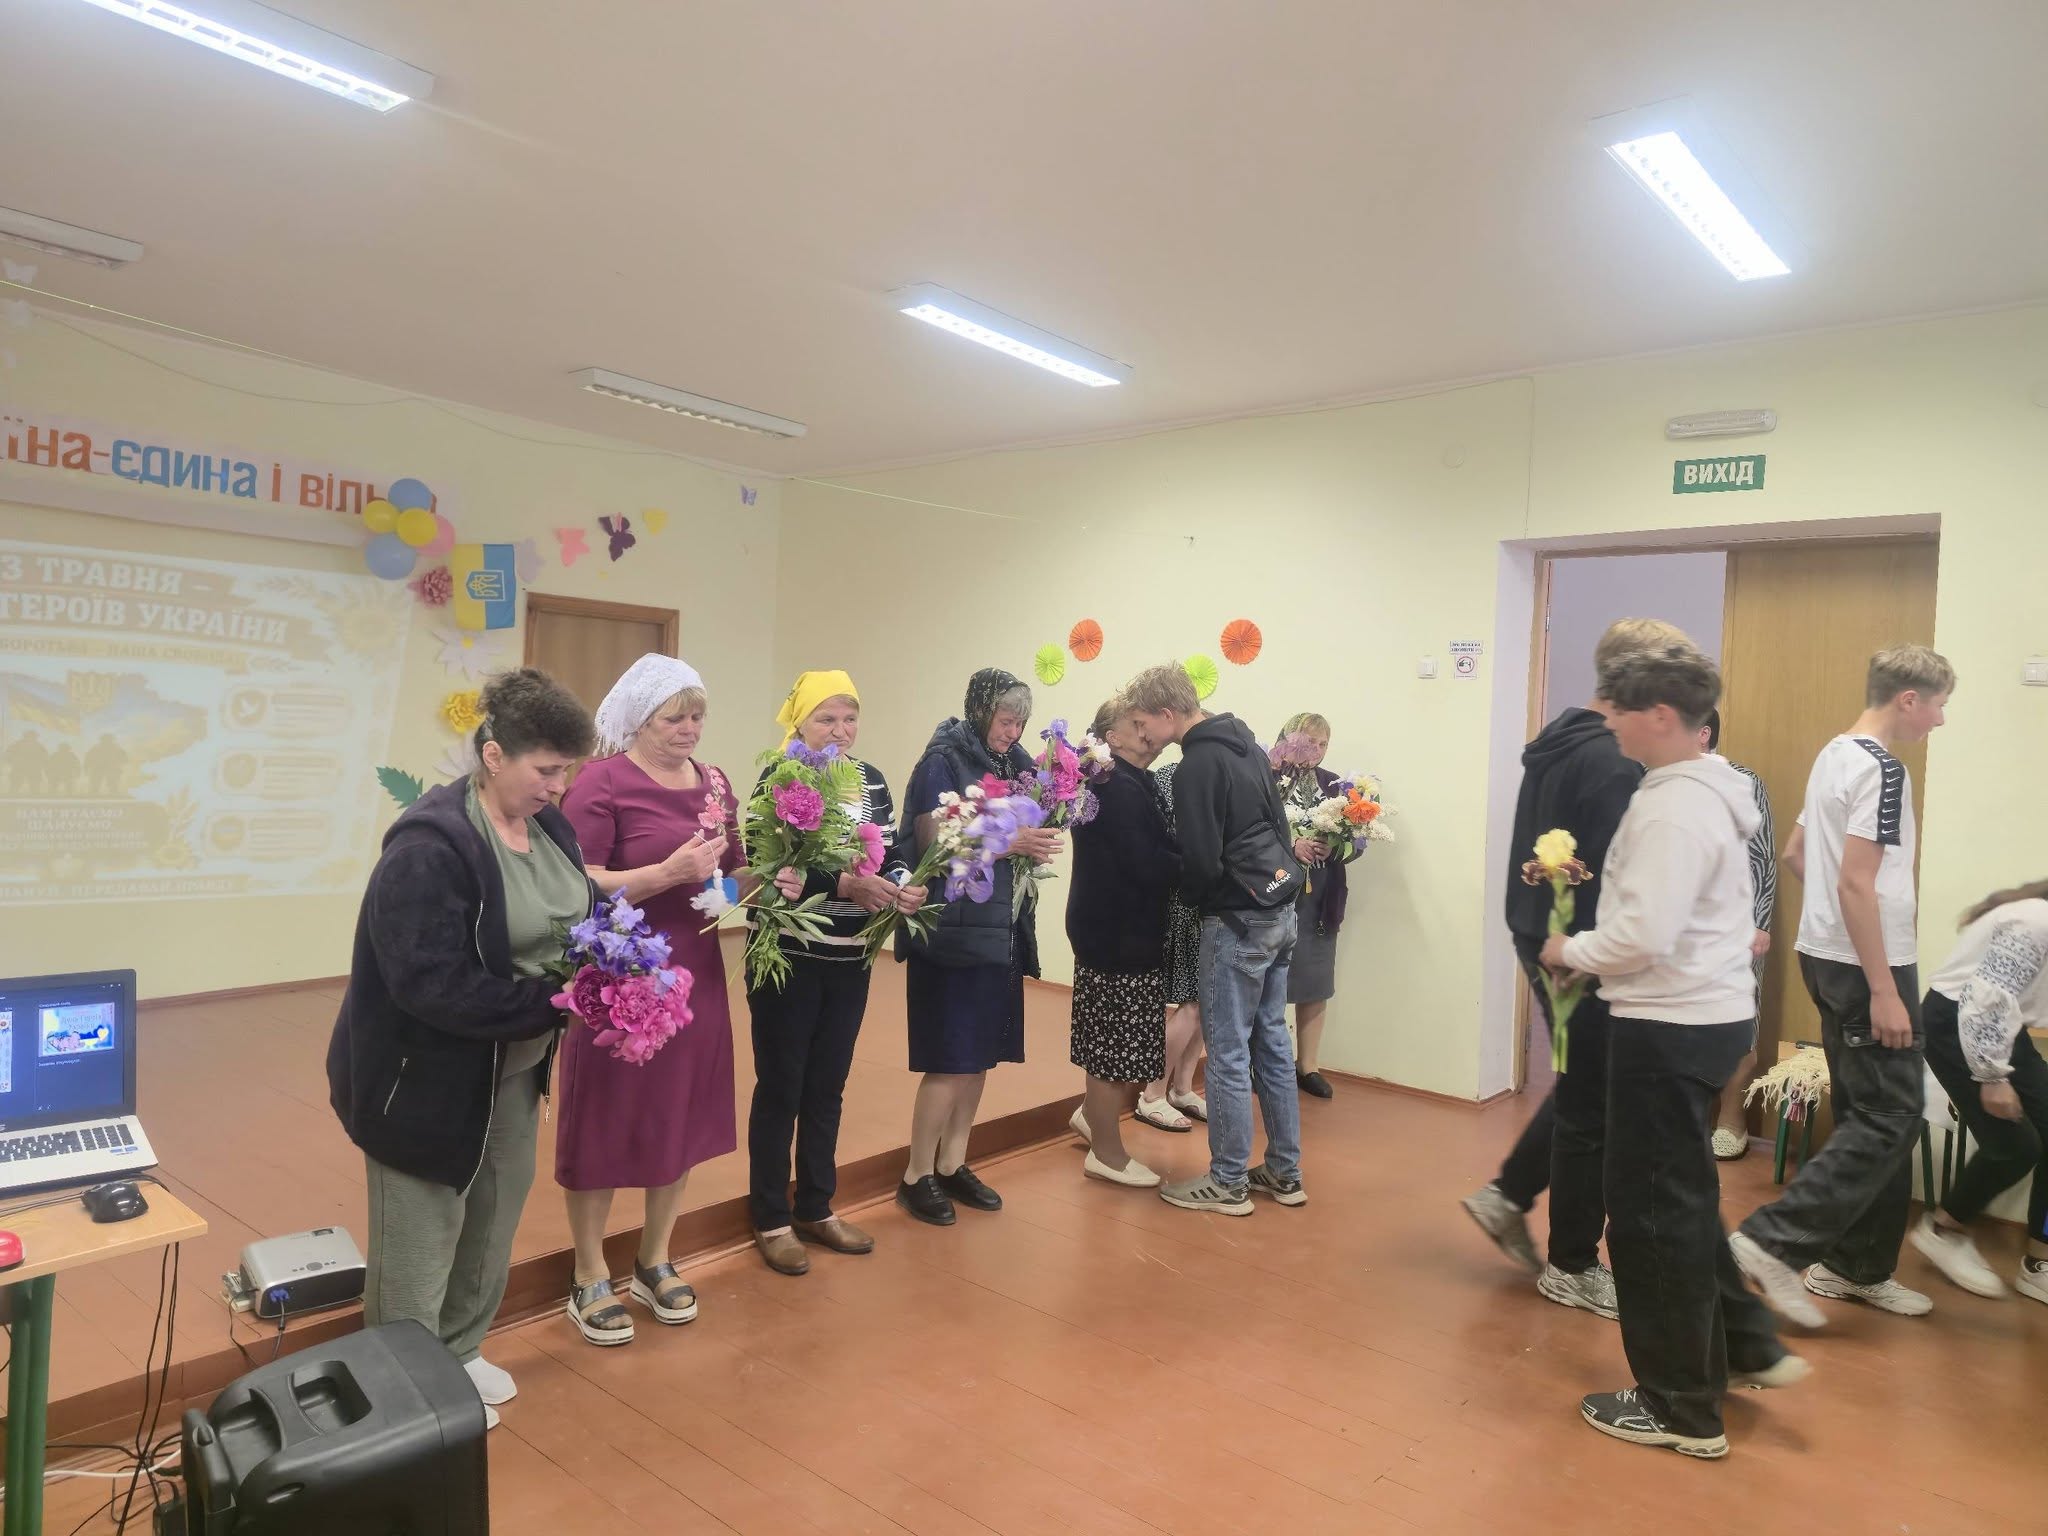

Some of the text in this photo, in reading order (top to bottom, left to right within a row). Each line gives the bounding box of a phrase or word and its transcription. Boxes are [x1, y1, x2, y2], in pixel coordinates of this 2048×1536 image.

[1683, 461, 1754, 486] ВИХІД
[37, 557, 182, 595] ТРАВНЯ
[0, 592, 288, 643] ГЕРОЇВ УКРАЇНИ
